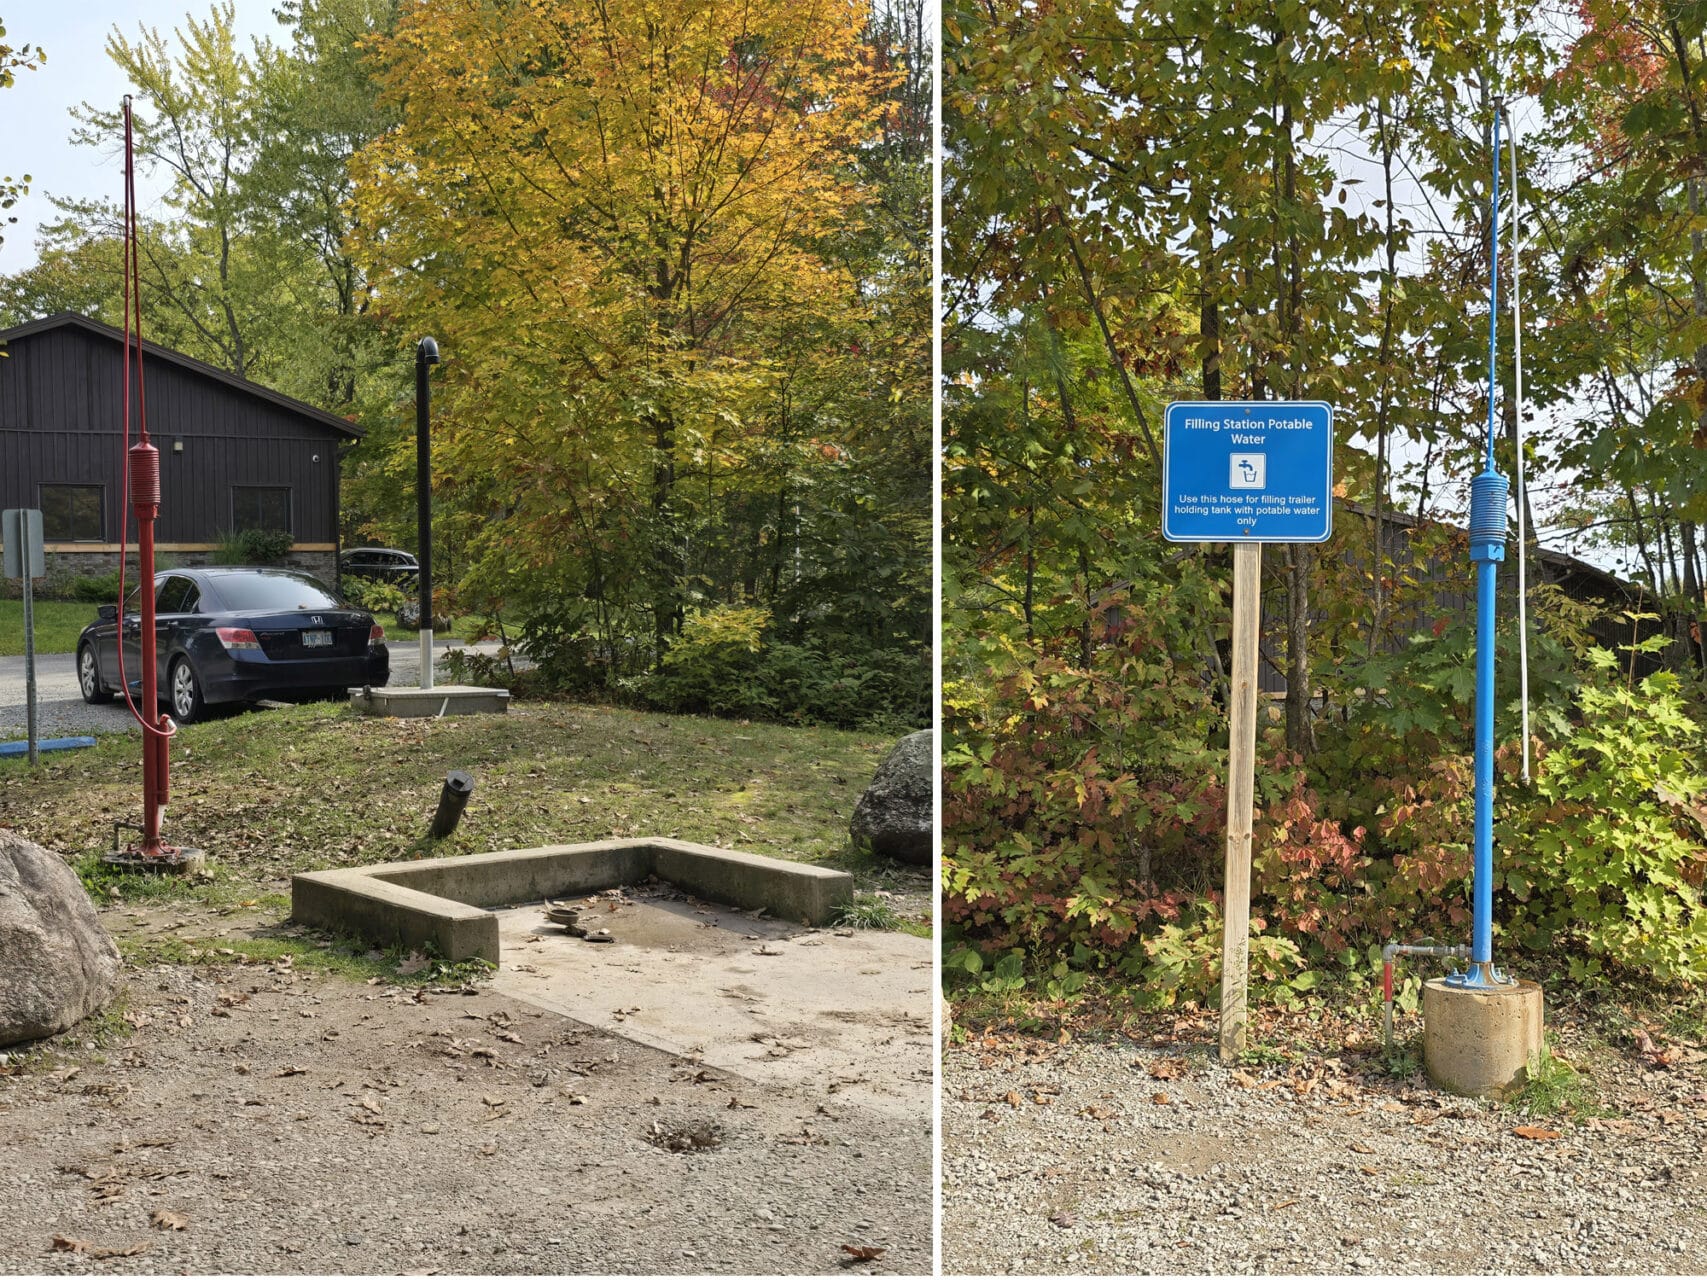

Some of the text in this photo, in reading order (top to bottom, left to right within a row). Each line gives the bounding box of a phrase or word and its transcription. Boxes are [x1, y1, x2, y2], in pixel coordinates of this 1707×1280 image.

[1185, 419, 1313, 431] Filling Station Potable
[1231, 434, 1265, 444] Water
[1179, 495, 1316, 506] Use this hose for filling trailer
[1174, 505, 1320, 516] holding tank with potable water
[1237, 516, 1257, 527] only
